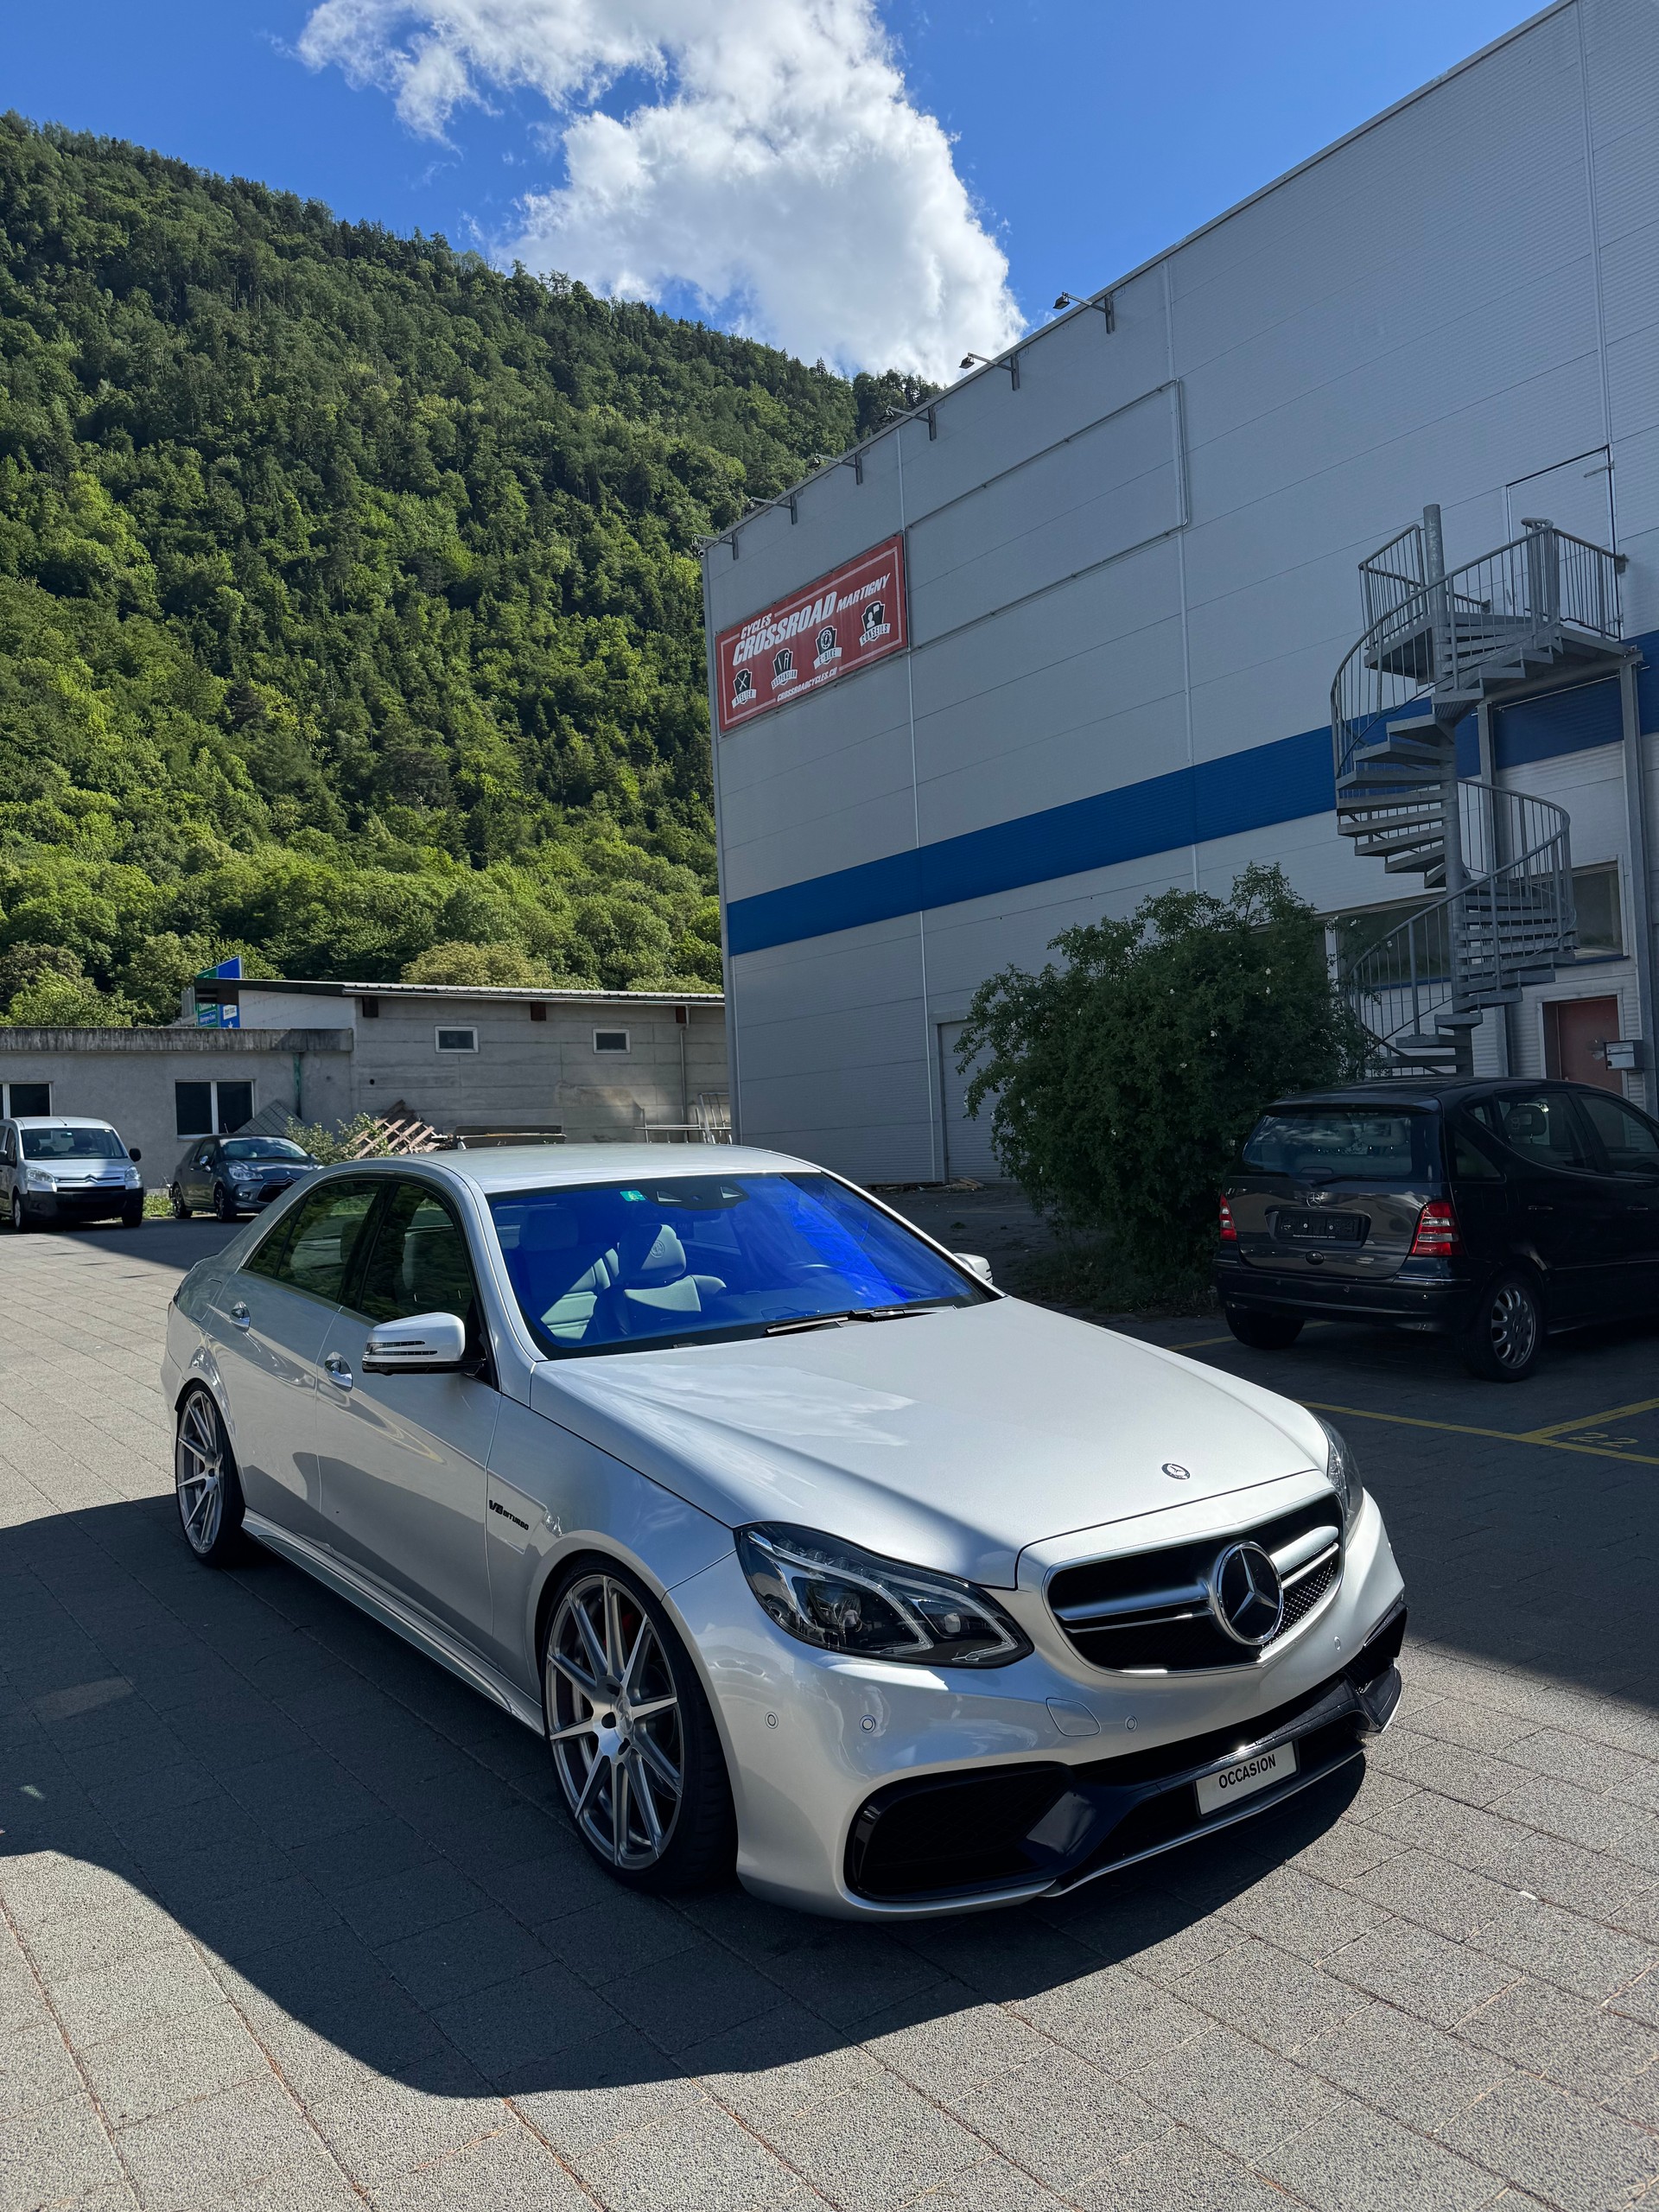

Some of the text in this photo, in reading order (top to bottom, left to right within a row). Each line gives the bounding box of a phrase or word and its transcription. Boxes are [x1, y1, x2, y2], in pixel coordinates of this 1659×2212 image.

[733, 573, 891, 665] CROSSROAD MARTIGNY
[741, 613, 772, 639] CYCLES
[861, 624, 888, 644] CONSEILS
[819, 648, 836, 664] E-BIKE
[772, 670, 797, 688] SUSPENSION
[735, 690, 753, 704] ATELIER
[489, 1500, 503, 1515] V8
[1218, 1753, 1276, 1789] OCCASION
